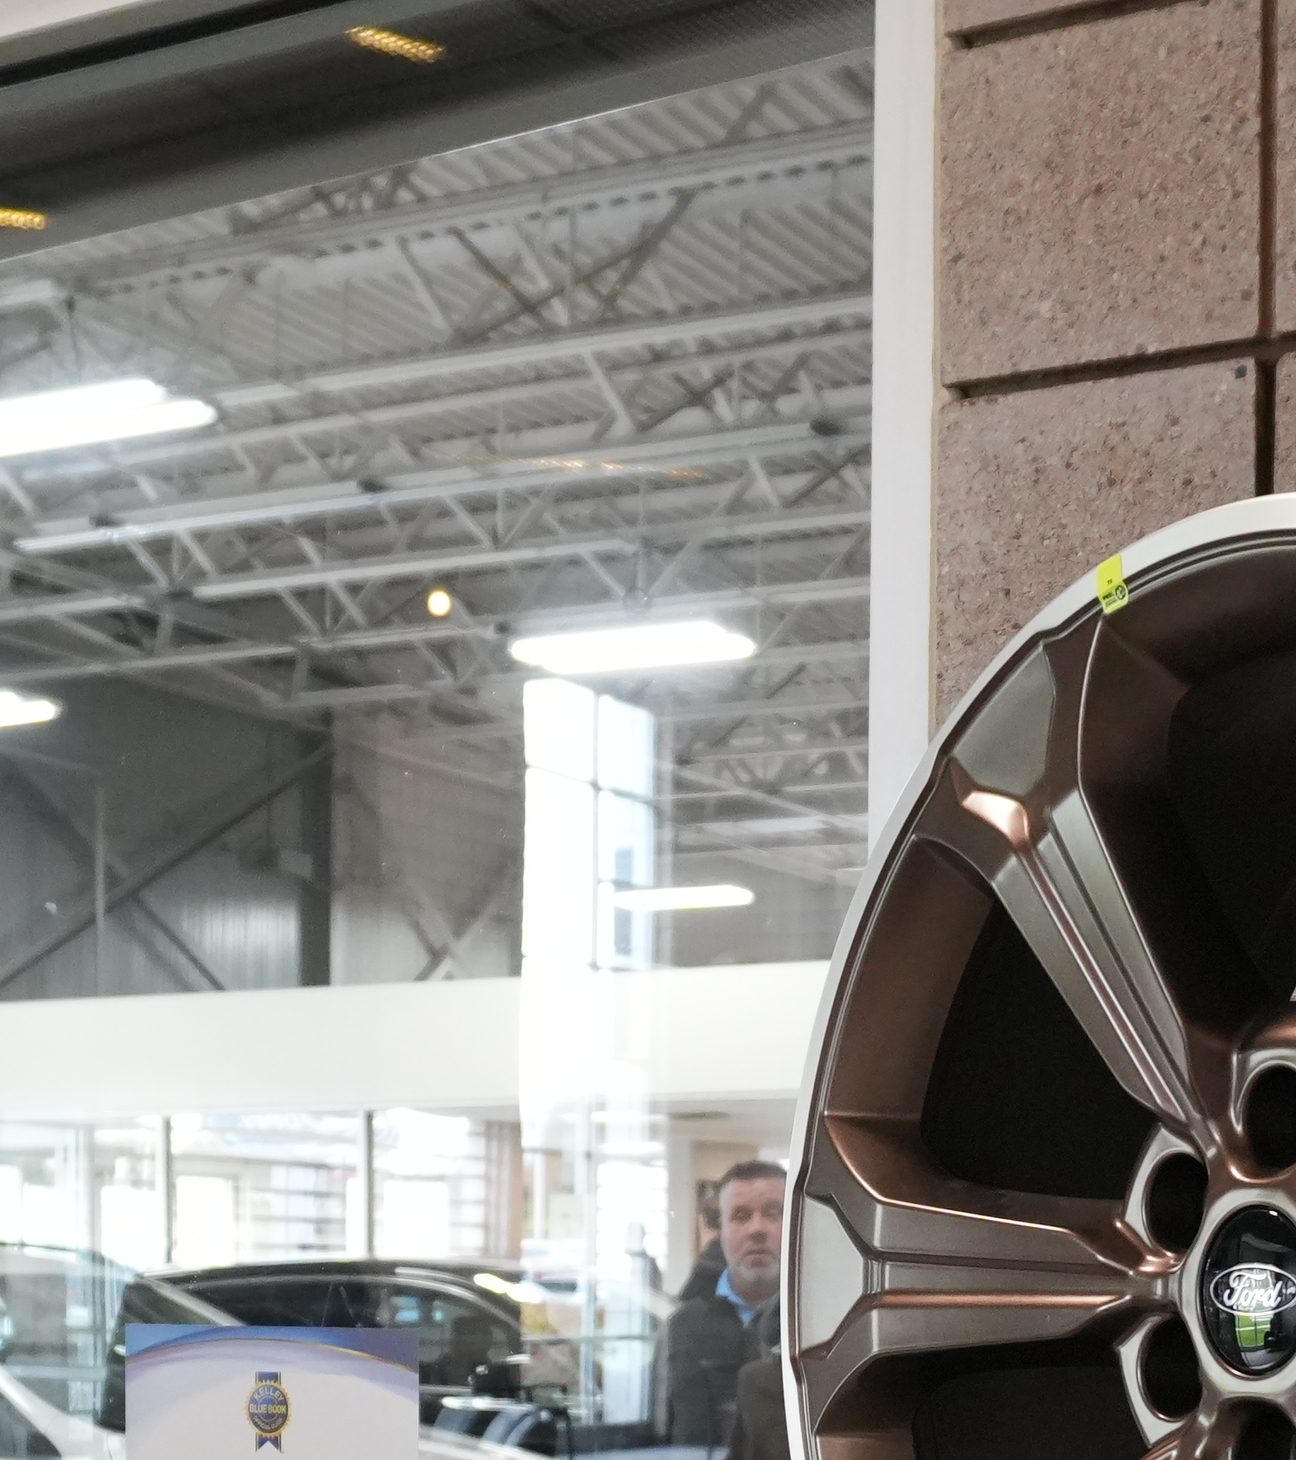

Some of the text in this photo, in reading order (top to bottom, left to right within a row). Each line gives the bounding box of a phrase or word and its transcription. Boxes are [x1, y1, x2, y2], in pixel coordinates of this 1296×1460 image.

[1223, 1269, 1283, 1310] Ford
[253, 1386, 285, 1401] KELLEY
[249, 1403, 287, 1415] BLUE BOOK
